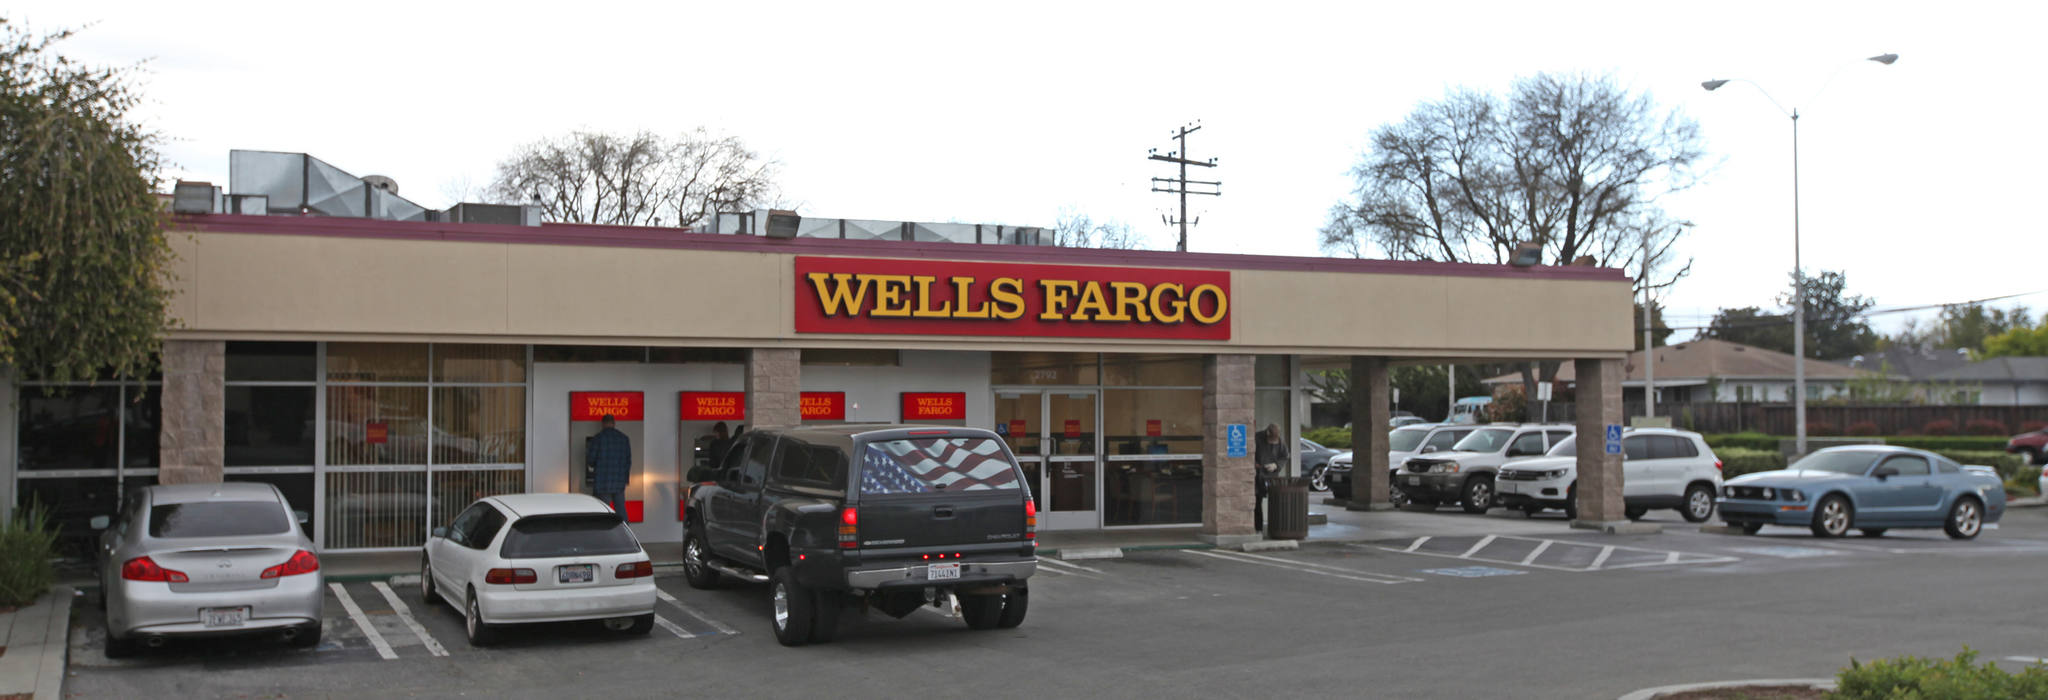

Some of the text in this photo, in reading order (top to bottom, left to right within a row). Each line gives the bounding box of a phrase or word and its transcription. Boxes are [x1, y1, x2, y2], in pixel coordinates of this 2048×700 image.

[806, 271, 1228, 325] WELLS FARGO
[587, 397, 629, 407] WELLS
[696, 397, 736, 406] WELLS
[917, 397, 953, 406] WELLS
[588, 407, 629, 416] FARGO
[697, 406, 735, 415] FARGO
[918, 406, 953, 415] FARGO
